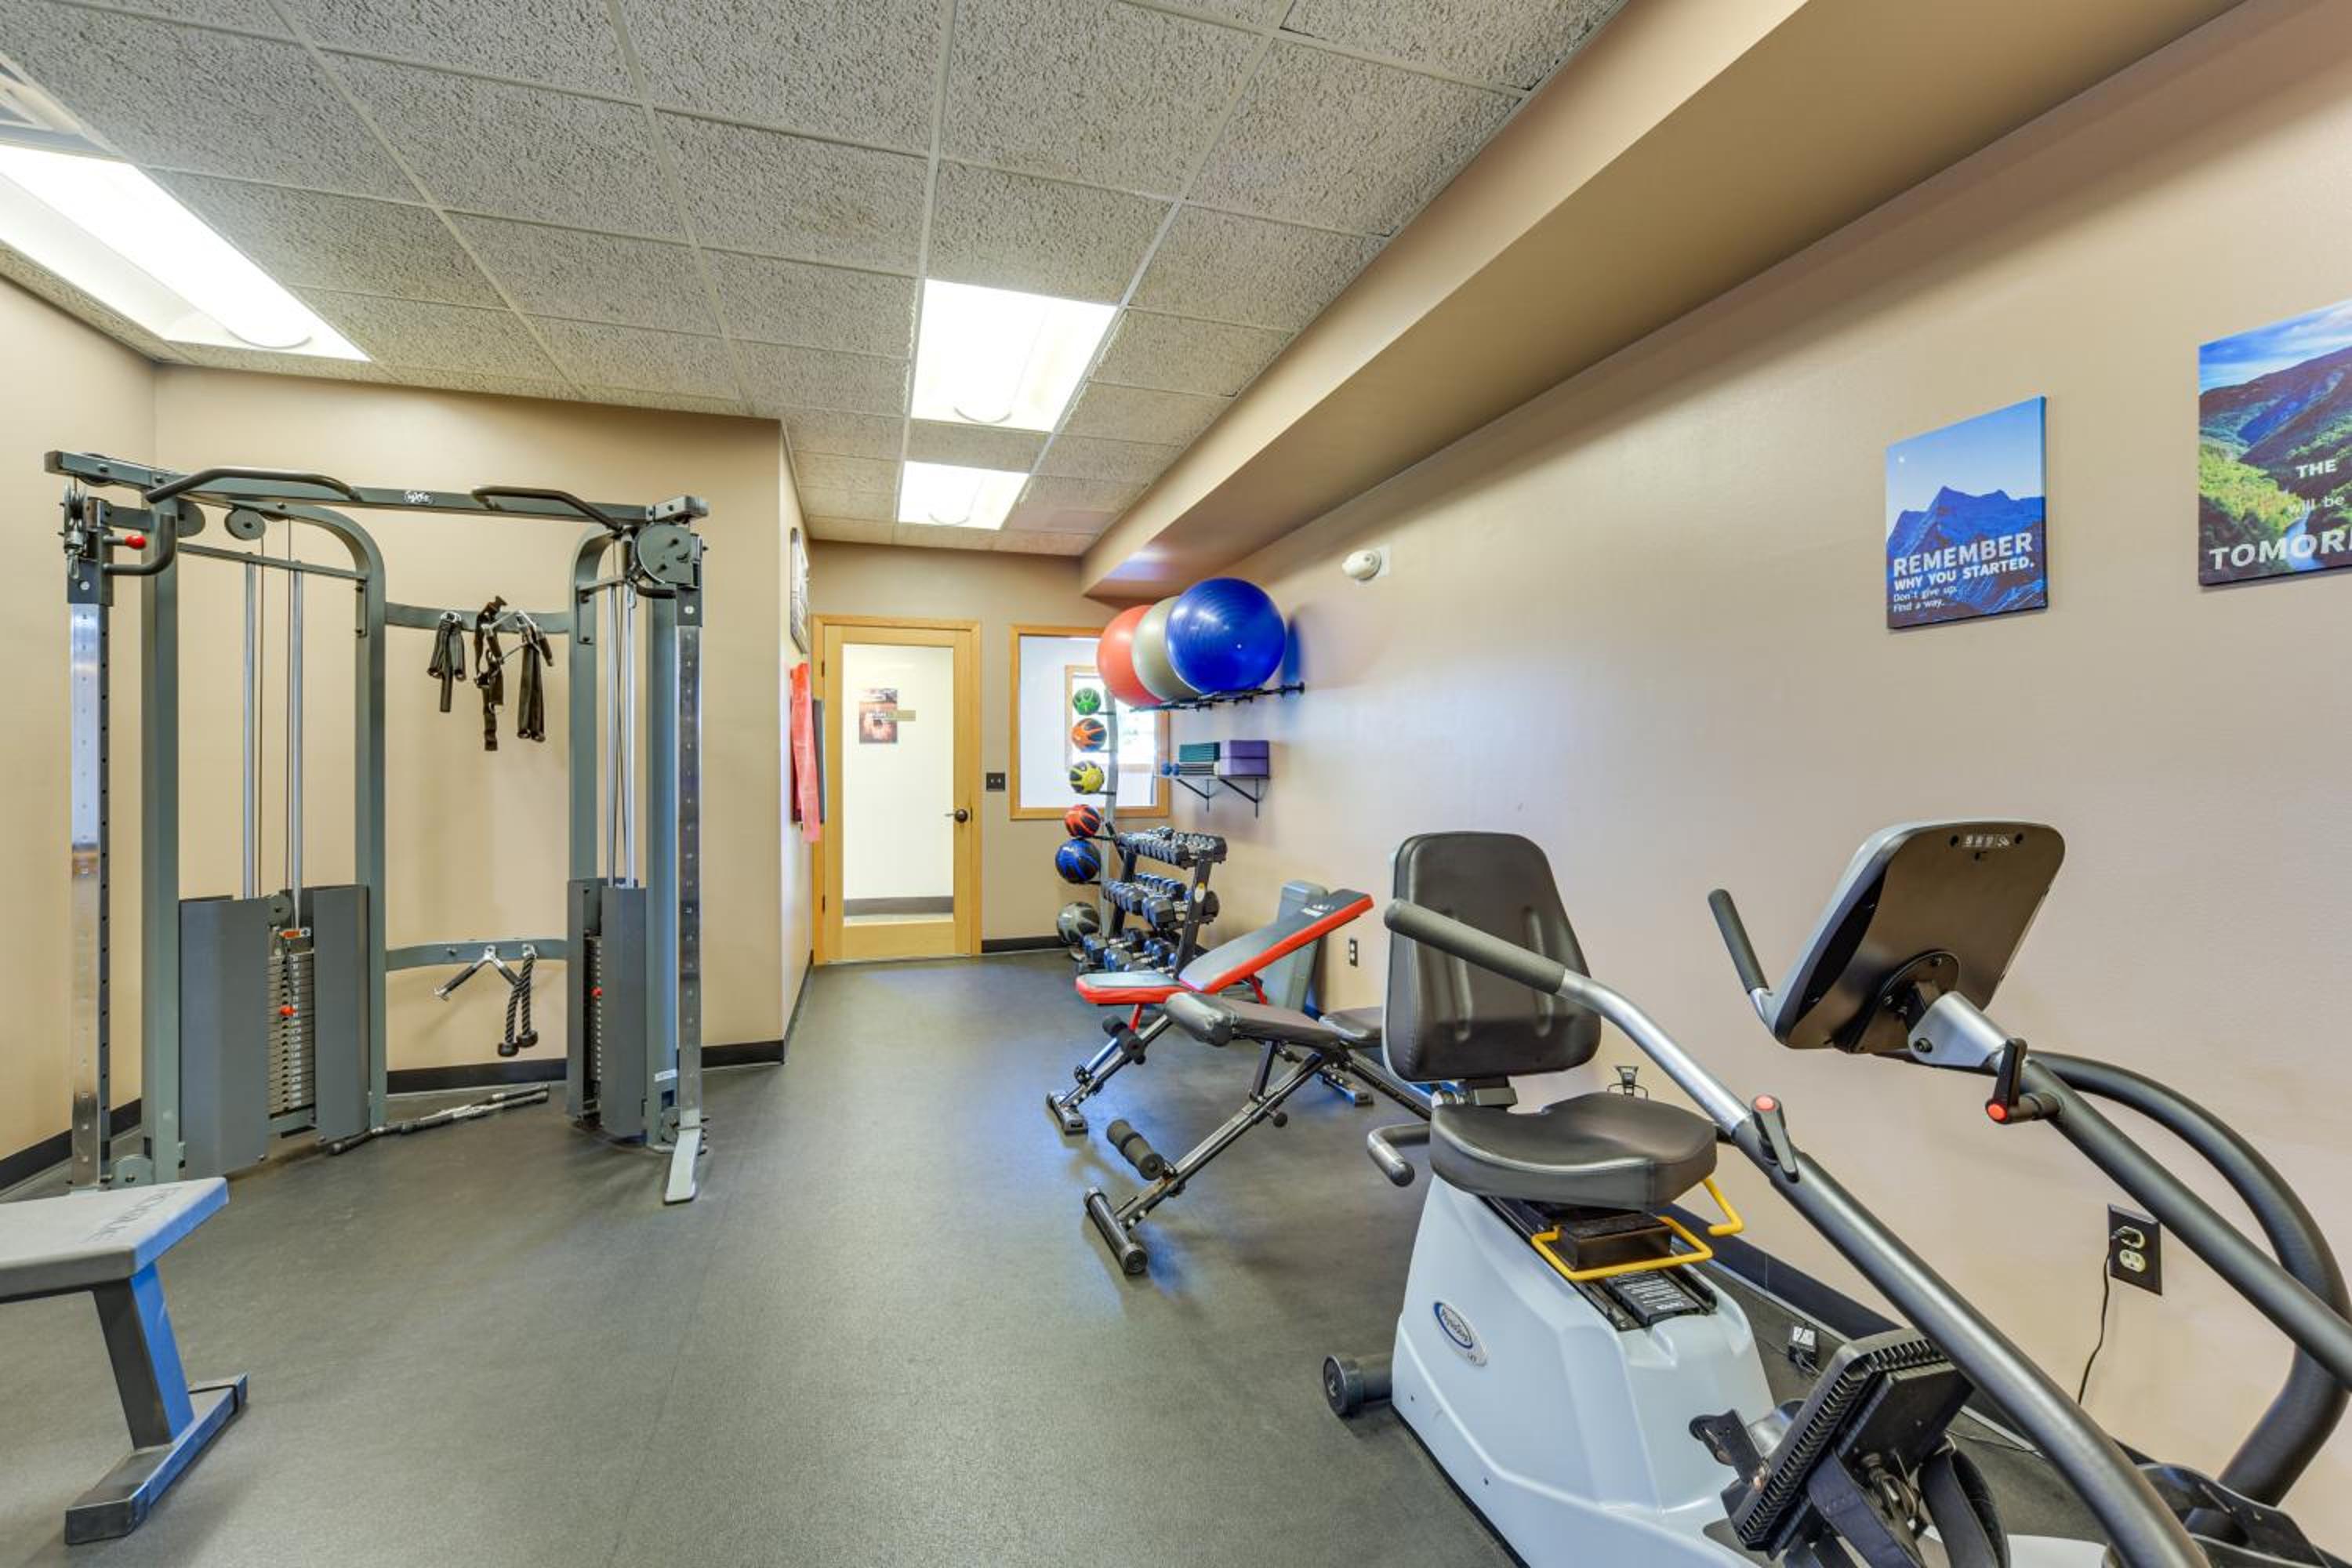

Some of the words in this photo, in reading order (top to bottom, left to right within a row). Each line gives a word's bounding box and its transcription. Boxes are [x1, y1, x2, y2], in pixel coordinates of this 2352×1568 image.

[2296, 459, 2337, 478] THE
[2323, 495, 2345, 507] be
[1893, 532, 2033, 578] REMEMBER
[2209, 526, 2352, 570] TOMOR
[1894, 576, 1922, 591] WHY
[1929, 570, 1956, 585] YOU
[1962, 556, 2035, 579] STARTED.
[1893, 590, 1918, 602] Don't
[1922, 588, 1939, 601] give
[1893, 601, 1912, 612] Find
[1925, 598, 1945, 610] way.
